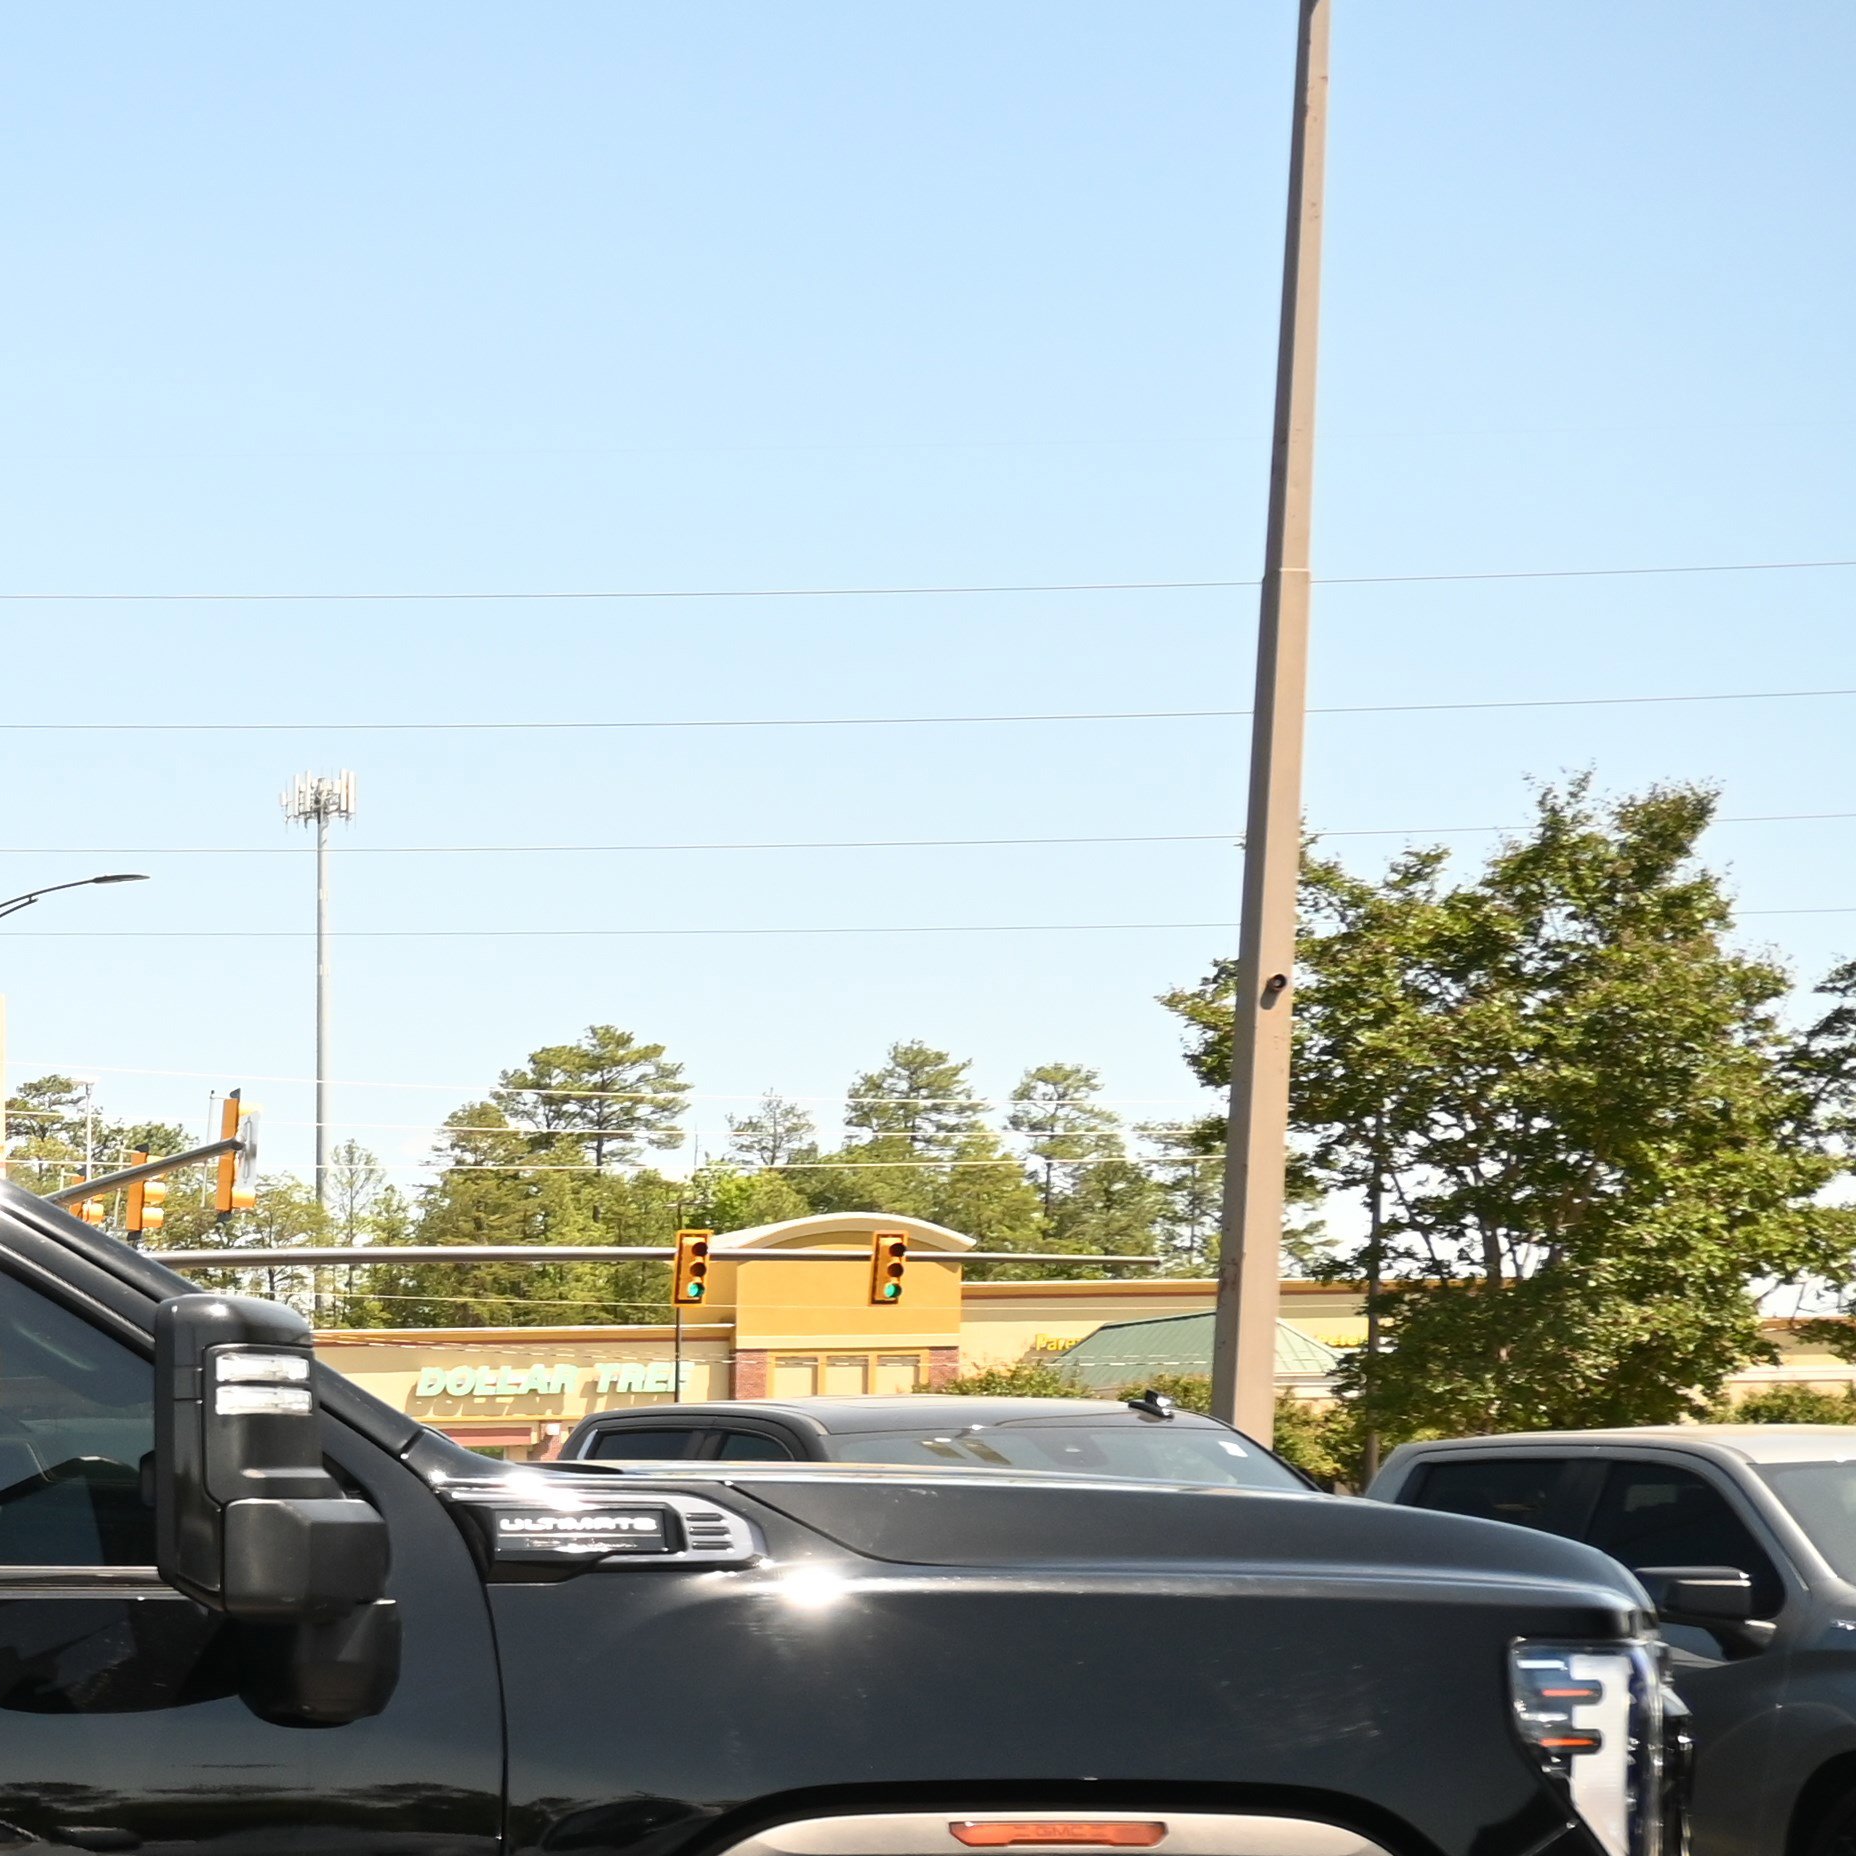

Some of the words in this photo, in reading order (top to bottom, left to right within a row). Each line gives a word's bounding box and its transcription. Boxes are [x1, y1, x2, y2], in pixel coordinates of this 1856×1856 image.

[415, 1362, 577, 1397] DOLLAR
[593, 1361, 695, 1393] TREE
[499, 1516, 658, 1531] ULTIMATE
